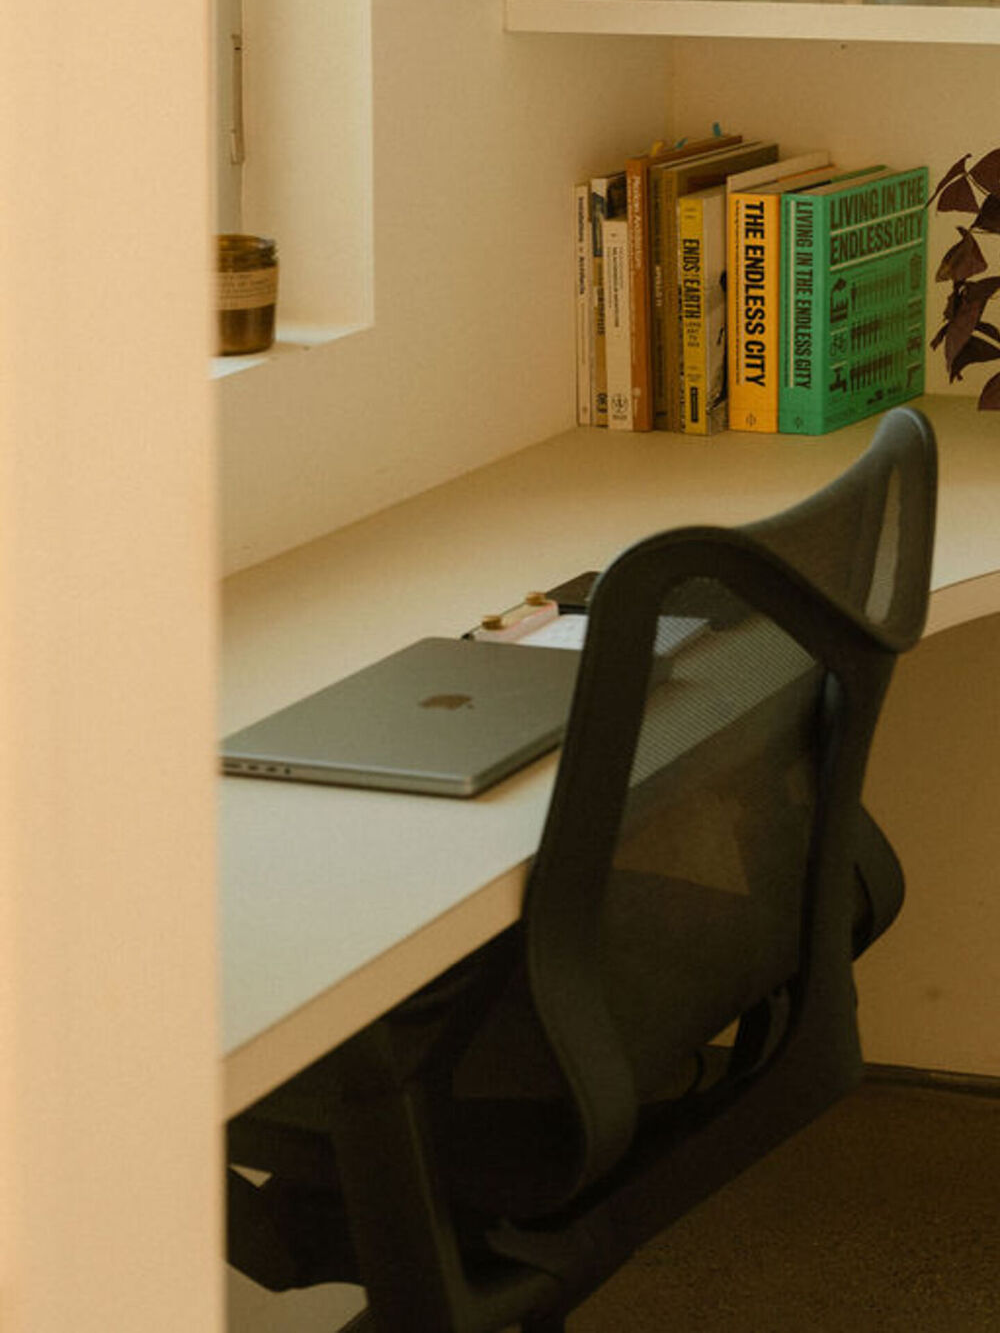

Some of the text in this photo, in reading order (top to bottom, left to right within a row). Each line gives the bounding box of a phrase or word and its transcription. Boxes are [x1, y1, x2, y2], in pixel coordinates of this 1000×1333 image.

[829, 174, 925, 230] LIVING IN THE
[829, 213, 923, 267] ENDLESS CITY
[683, 238, 701, 319] ENDS EARTH
[744, 201, 766, 387] THE ENDLESS CITY
[795, 201, 813, 390] LIVING IN THE ENDLESS CITY
